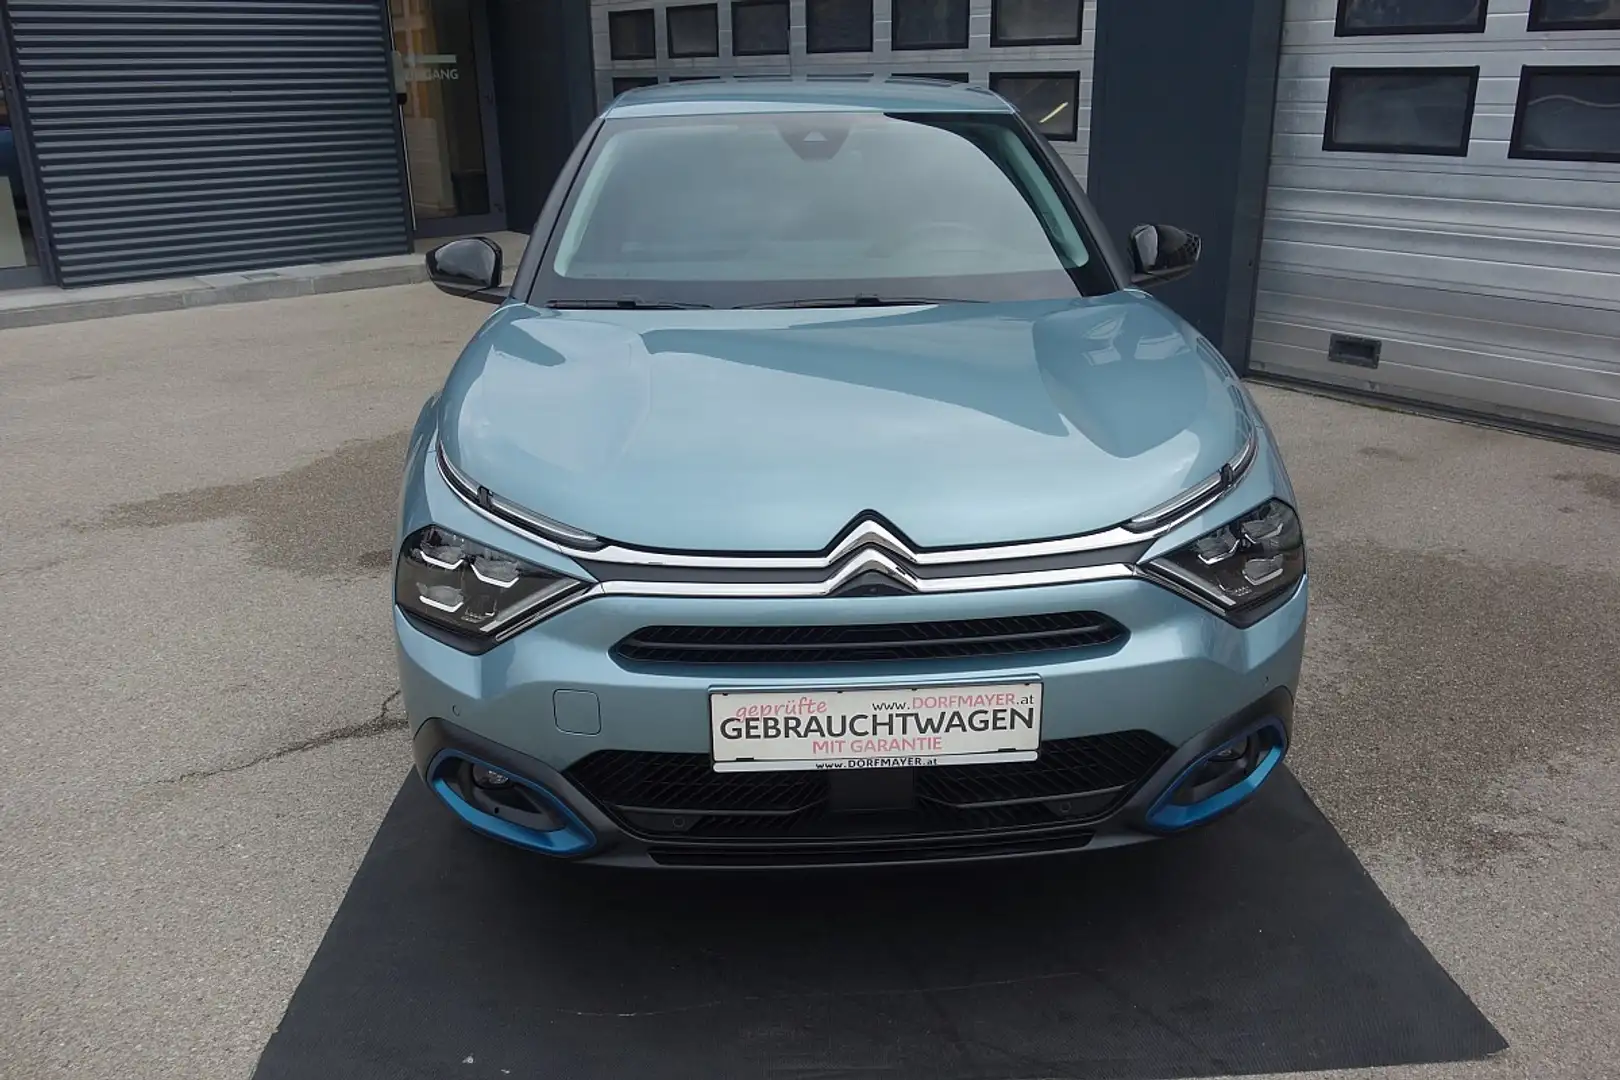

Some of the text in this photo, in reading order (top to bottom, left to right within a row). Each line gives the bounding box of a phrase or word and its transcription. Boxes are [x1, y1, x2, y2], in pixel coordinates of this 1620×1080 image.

[736, 696, 828, 722] geprüfte
[872, 693, 1035, 712] www.DORFMAYER.at
[720, 707, 1034, 740] GEBRAUCHTWAGEN
[812, 737, 942, 754] MIT GARANTIE
[815, 757, 938, 770] www.DORFMAYER.at
